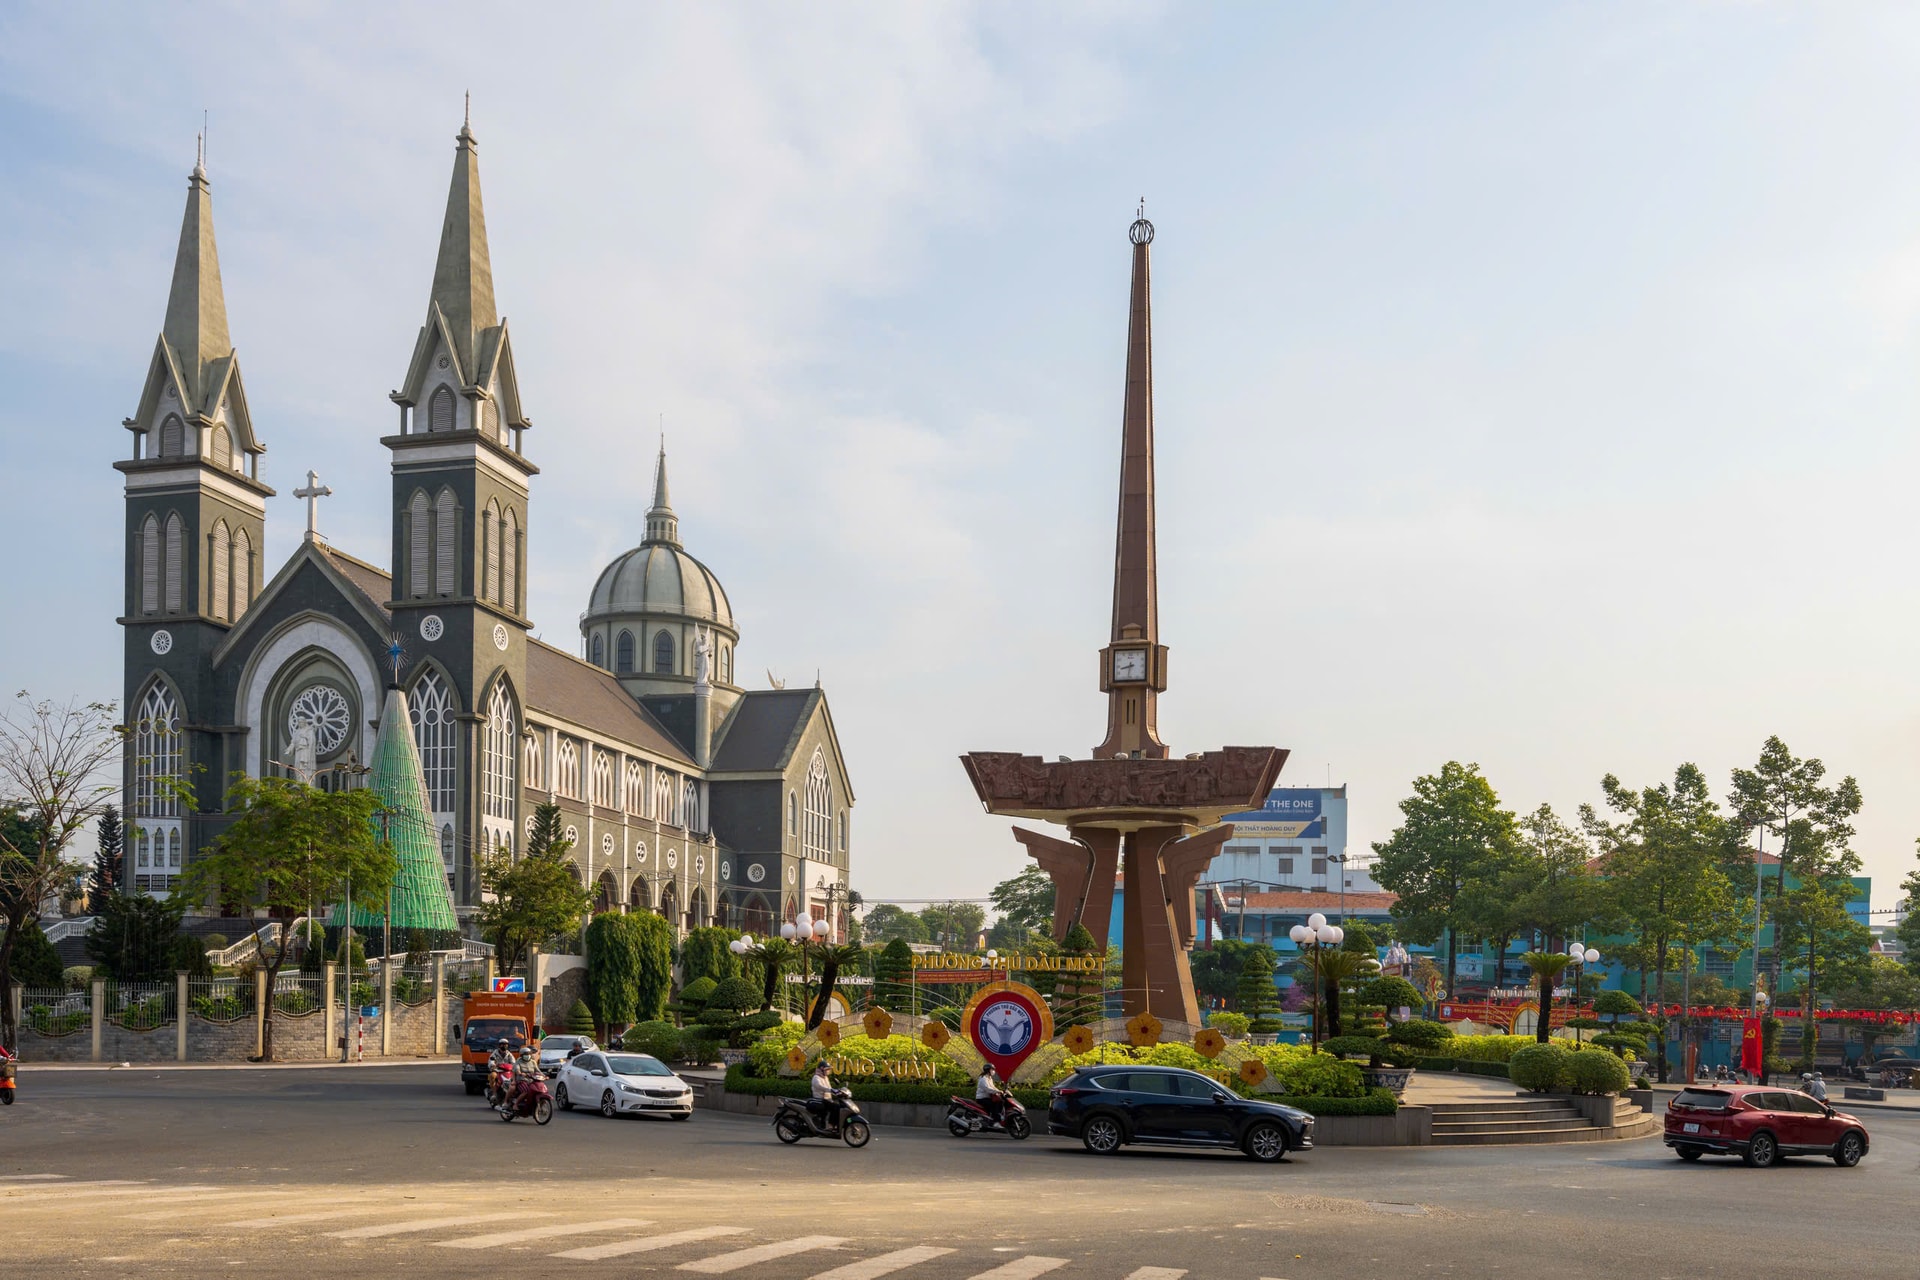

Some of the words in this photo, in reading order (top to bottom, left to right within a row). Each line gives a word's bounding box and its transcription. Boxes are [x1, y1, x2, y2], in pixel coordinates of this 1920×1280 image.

[1271, 800, 1291, 808] THE
[1293, 800, 1314, 808] ONE
[911, 953, 984, 970] PHƯỜNG
[988, 951, 1021, 971] THỦ
[1025, 951, 1061, 972] DẦU
[1066, 953, 1106, 976] MỘT
[881, 1055, 936, 1080] XUÂN
